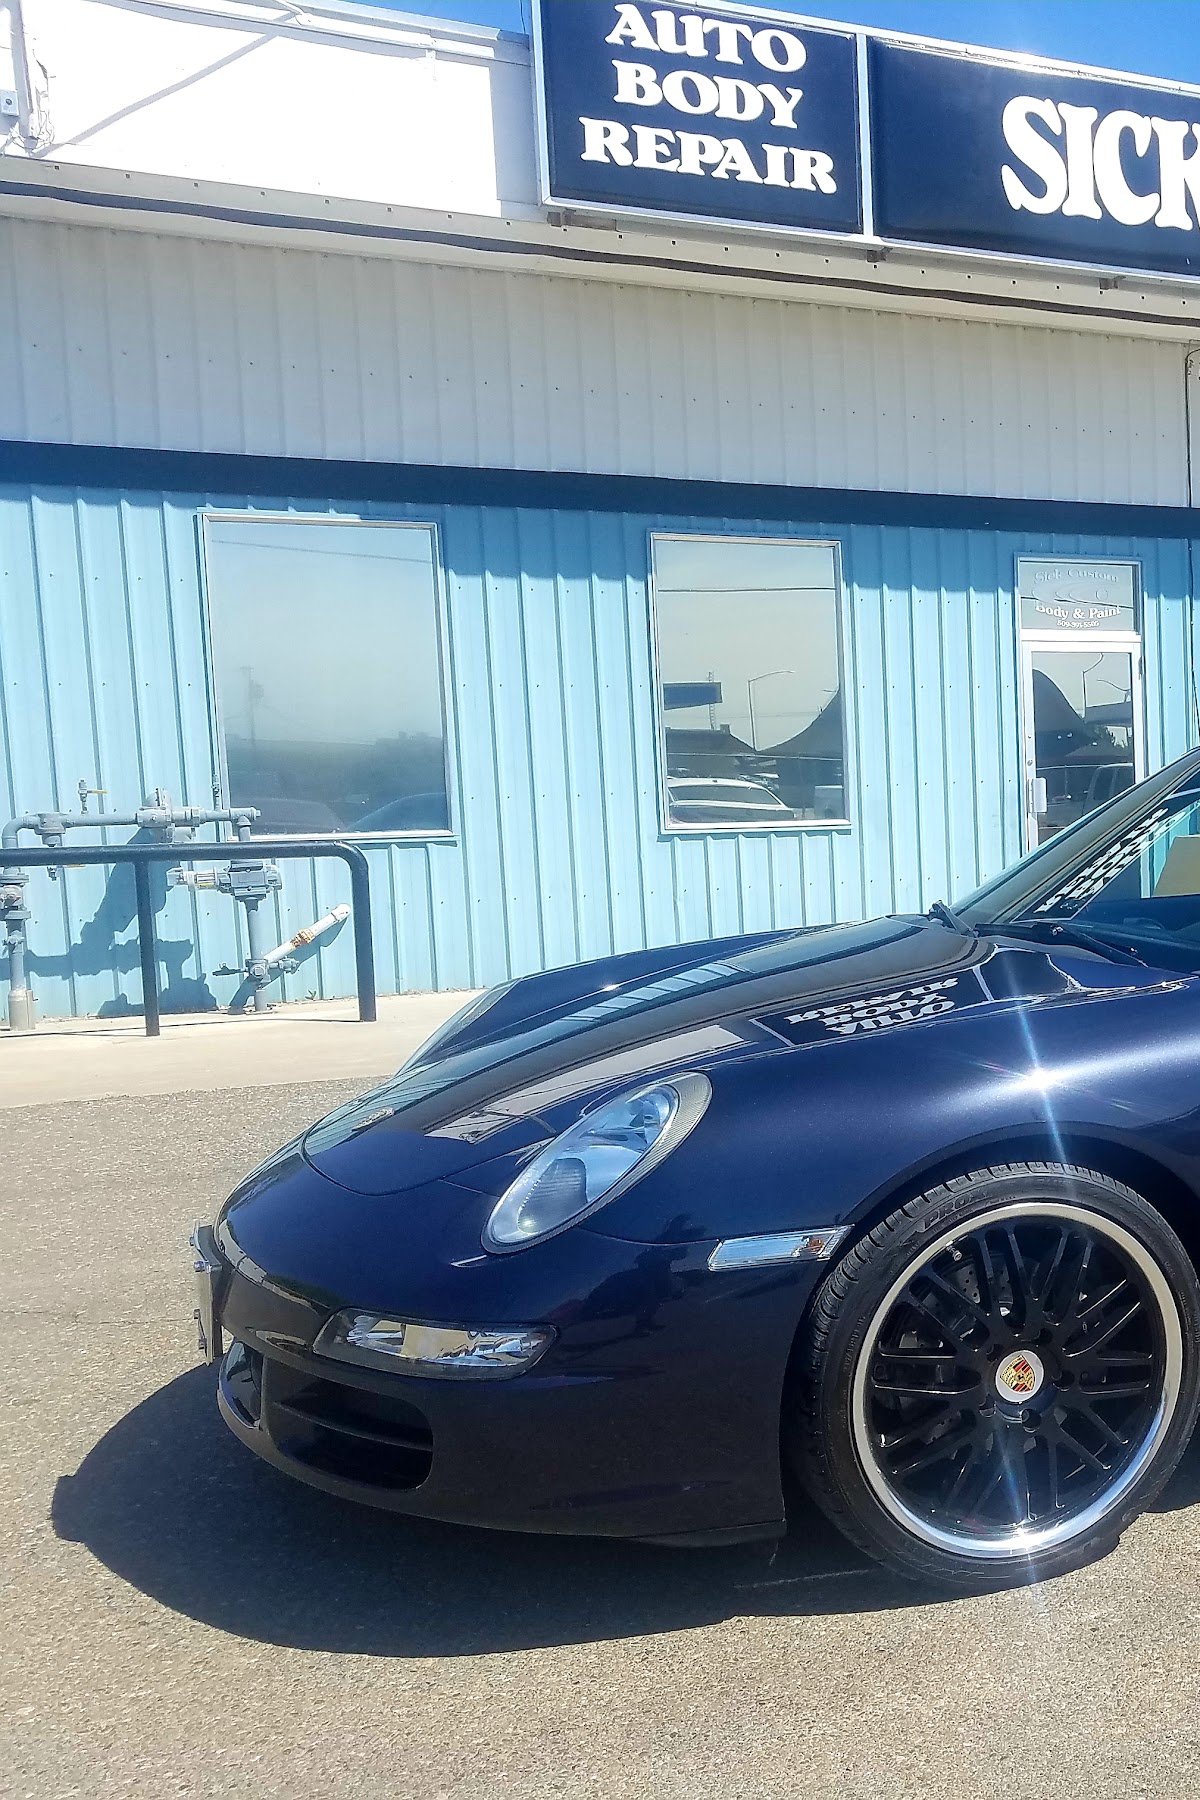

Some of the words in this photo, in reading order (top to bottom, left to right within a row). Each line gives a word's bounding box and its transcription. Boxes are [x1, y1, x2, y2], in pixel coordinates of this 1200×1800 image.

[604, 3, 807, 73] AUTO
[611, 59, 804, 129] BODY
[580, 117, 837, 194] REPAIR
[1072, 607, 1085, 619] &
[1088, 605, 1122, 619] Paint
